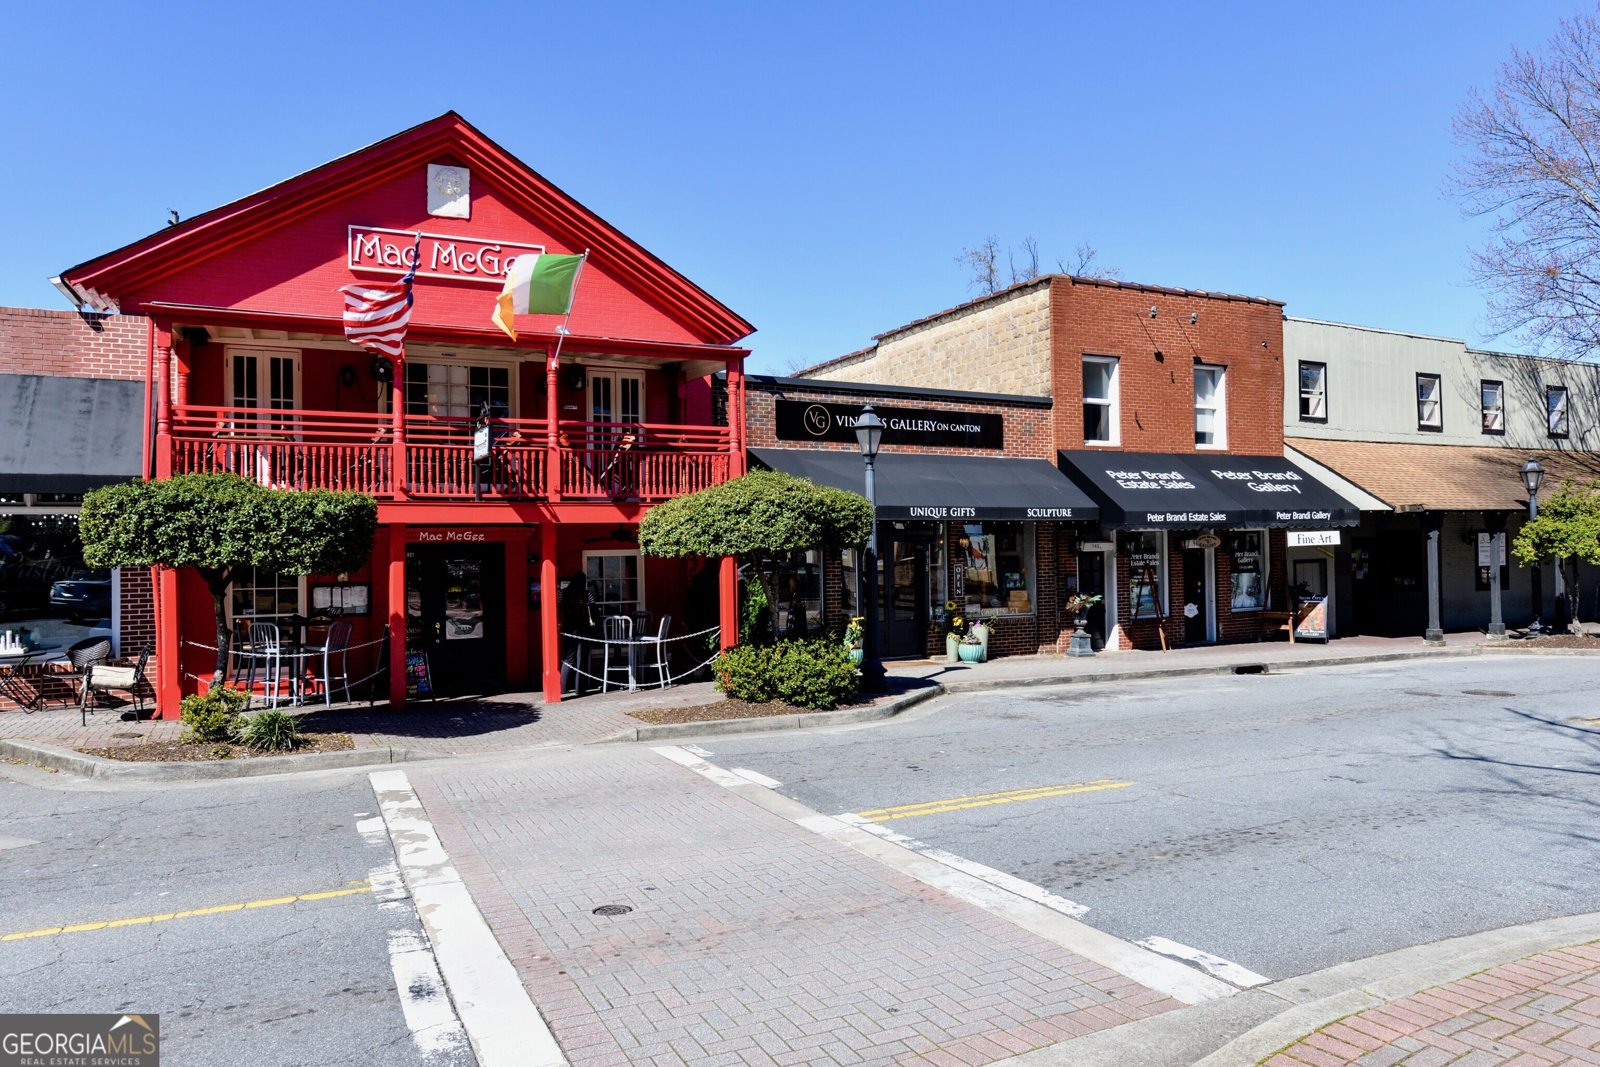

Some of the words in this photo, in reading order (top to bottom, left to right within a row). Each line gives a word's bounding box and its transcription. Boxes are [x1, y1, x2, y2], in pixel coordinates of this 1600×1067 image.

[353, 233, 421, 268] Mac
[430, 241, 518, 277] McGe
[809, 411, 826, 429] VG
[836, 415, 887, 429] VINS
[890, 418, 937, 432] GALLERY
[936, 423, 949, 431] ON
[950, 424, 981, 433] CANTON
[1105, 470, 1142, 480] Peter
[1141, 470, 1185, 480] Brandi
[1210, 470, 1254, 480] Peter
[1252, 470, 1303, 481] Brandi
[1116, 480, 1161, 489] Estate
[1159, 480, 1196, 489] Sales
[1247, 482, 1302, 494] Gallery
[910, 507, 948, 518] UNIQUE
[950, 507, 976, 517] GIFTS
[1027, 508, 1072, 518] SCULPTURE
[1147, 513, 1165, 522] Peter
[1166, 513, 1188, 522] Brandi
[1188, 513, 1208, 521] Estate
[1209, 512, 1227, 521] Sales
[1276, 511, 1291, 520] Peter
[1292, 511, 1311, 520] Brandi
[1312, 511, 1332, 521] Gallery
[419, 531, 443, 541] Mac
[446, 531, 485, 542] McGee
[1297, 533, 1315, 544] Fine
[1317, 533, 1332, 543] Art
